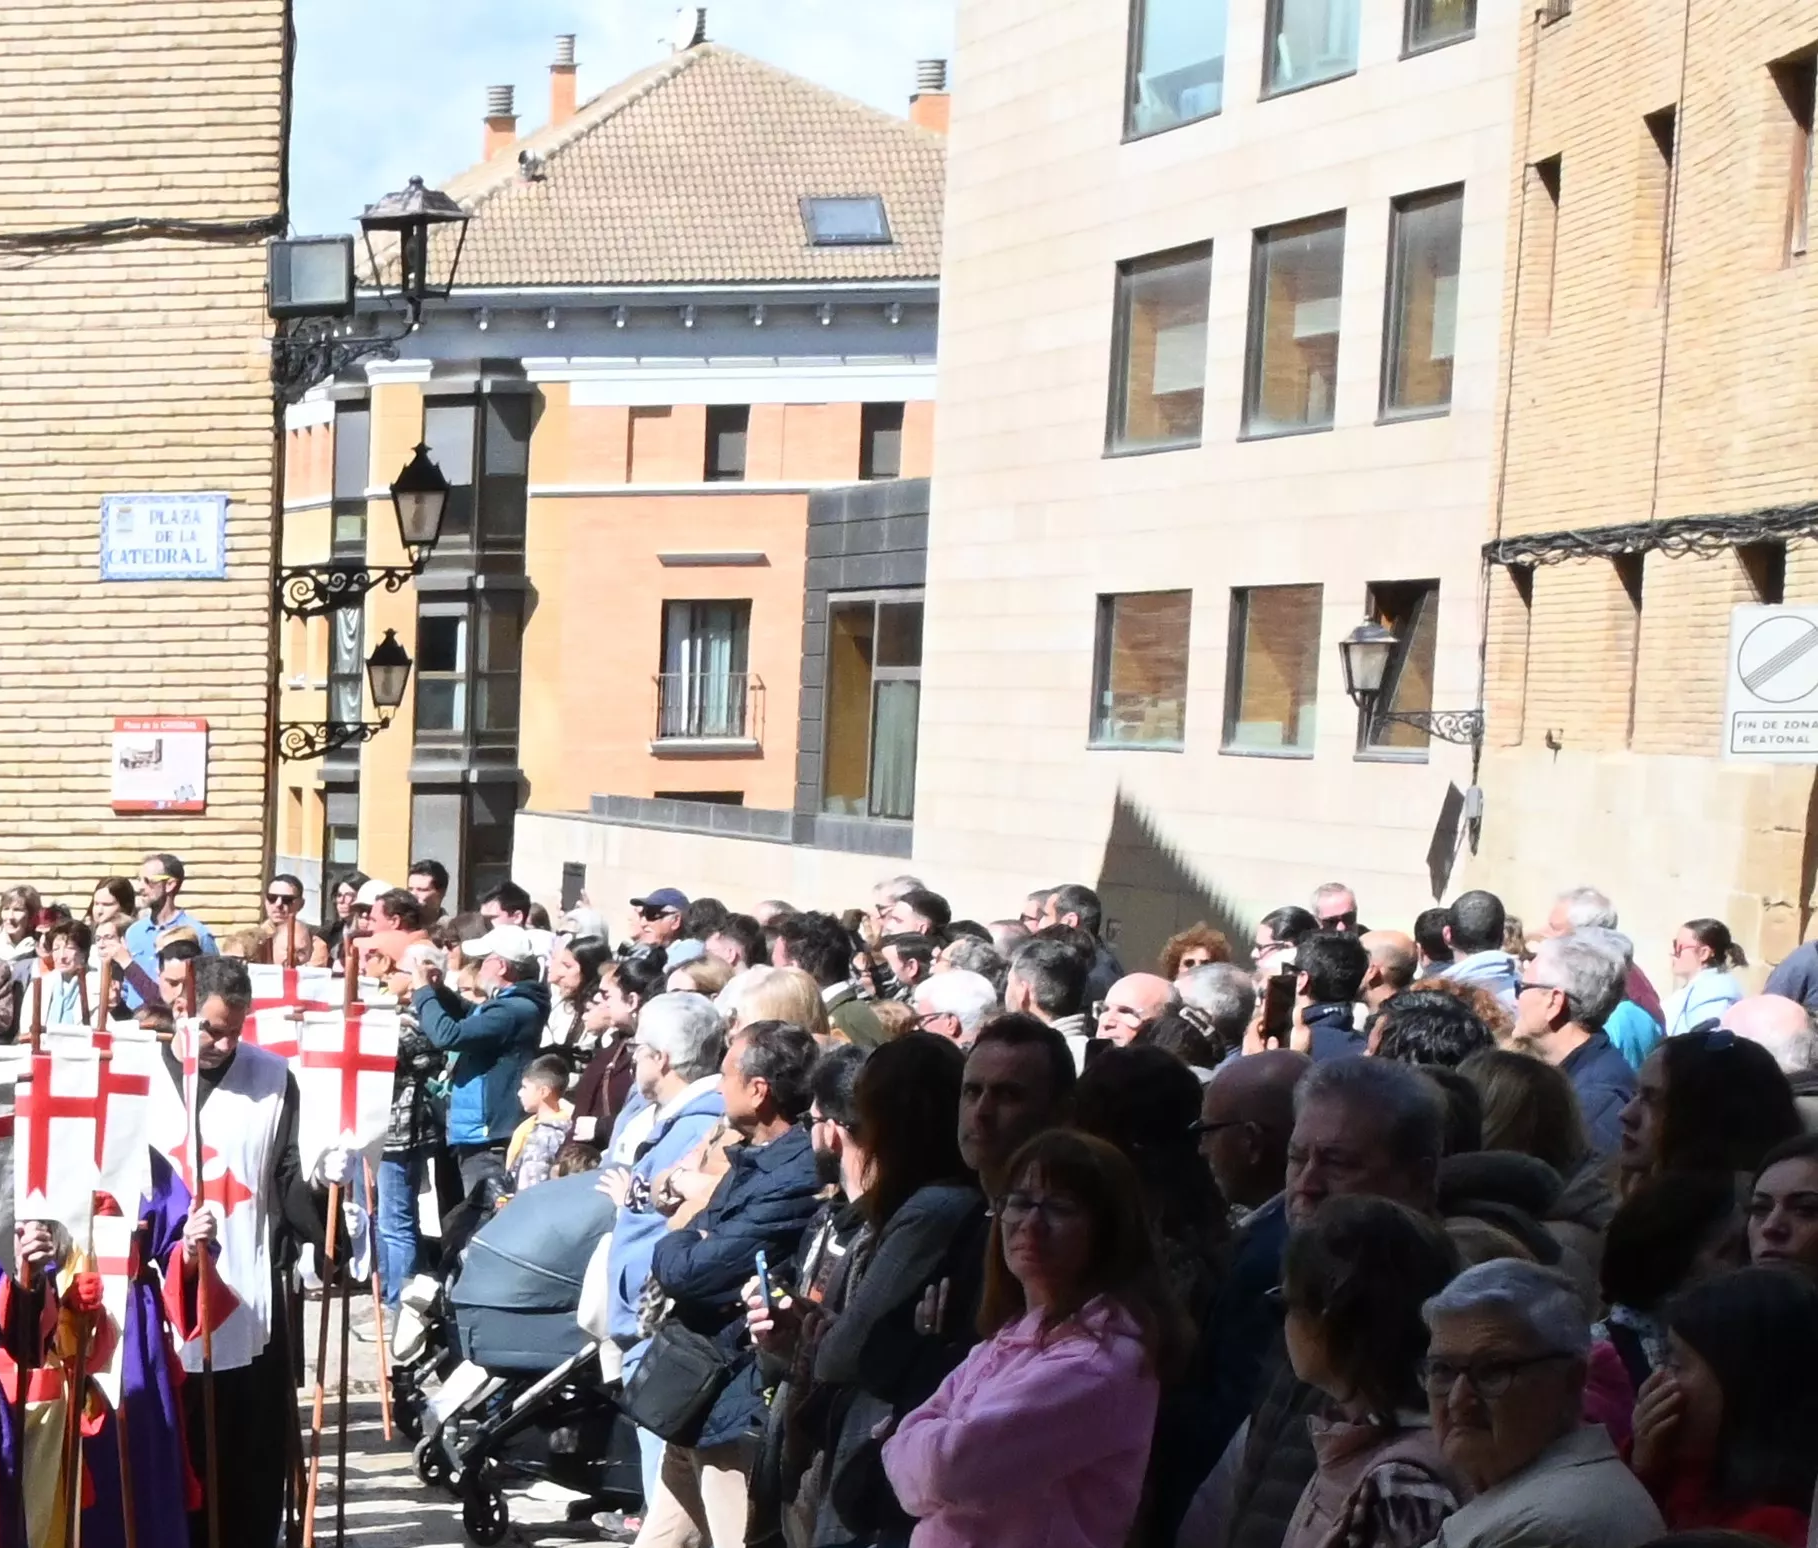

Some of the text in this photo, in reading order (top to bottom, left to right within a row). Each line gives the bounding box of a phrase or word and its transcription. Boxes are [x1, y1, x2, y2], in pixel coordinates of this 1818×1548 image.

[149, 509, 202, 526] PLAZA
[155, 530, 197, 543] DE LA
[108, 548, 208, 564] CATEDRAL
[1736, 720, 1757, 729] FIN
[1762, 720, 1778, 729] DE
[1742, 735, 1811, 744] PEATONAL
